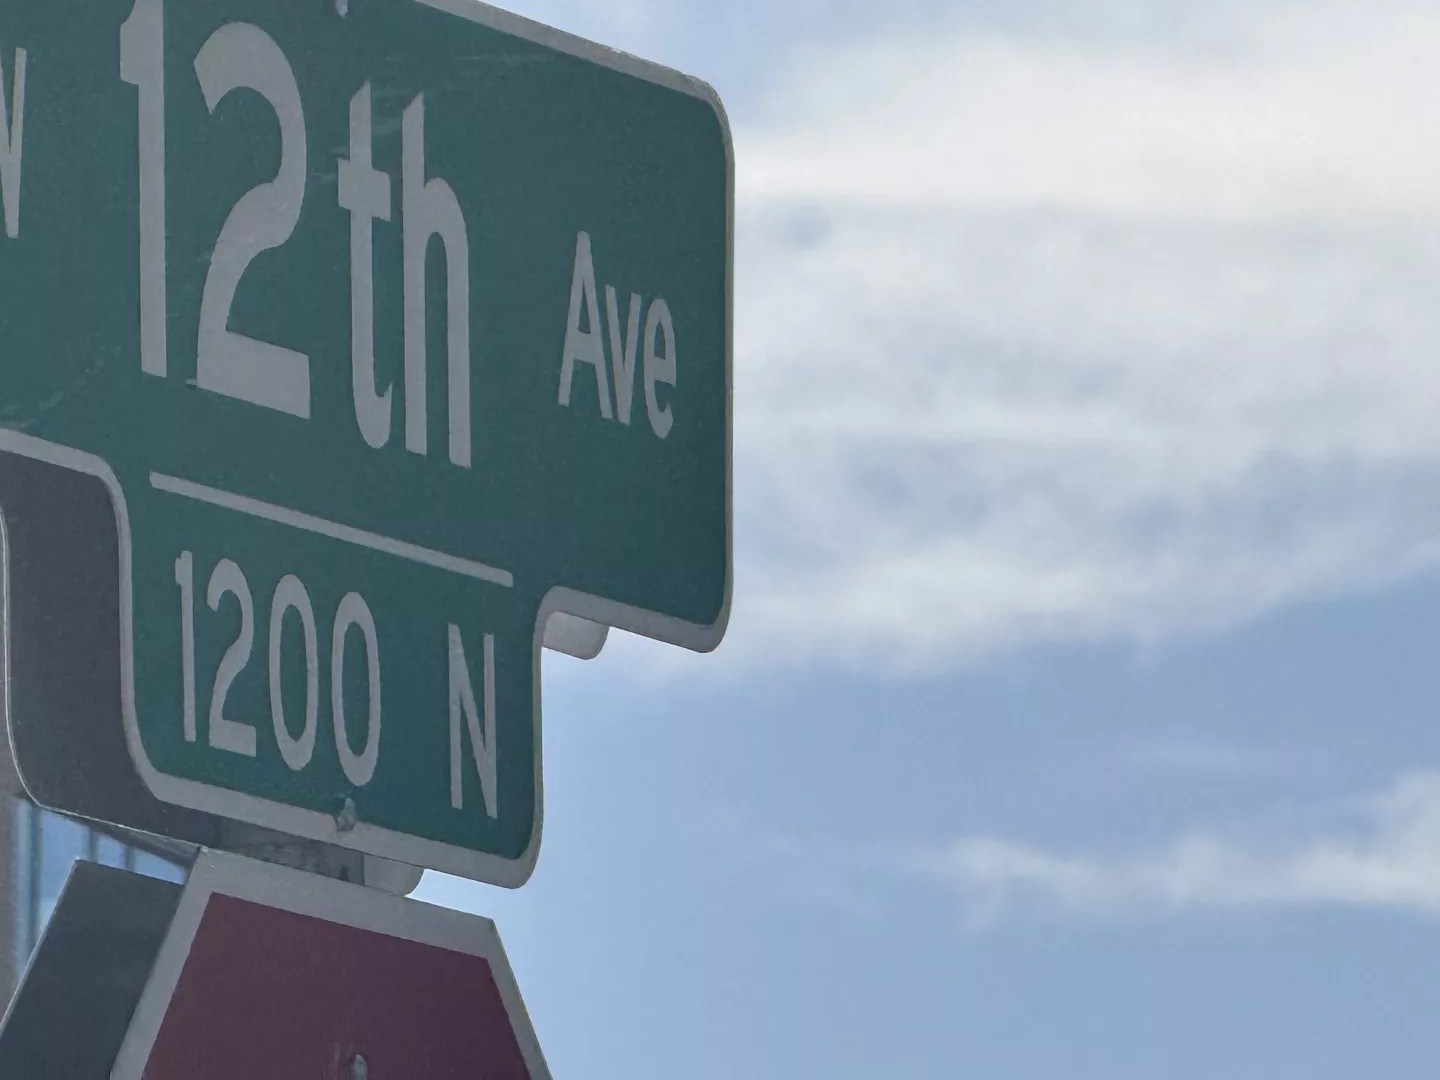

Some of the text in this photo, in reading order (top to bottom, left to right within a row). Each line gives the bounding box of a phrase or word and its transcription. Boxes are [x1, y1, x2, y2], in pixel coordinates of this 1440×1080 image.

[557, 230, 678, 439] Ave
[173, 548, 498, 820] 1200 N
